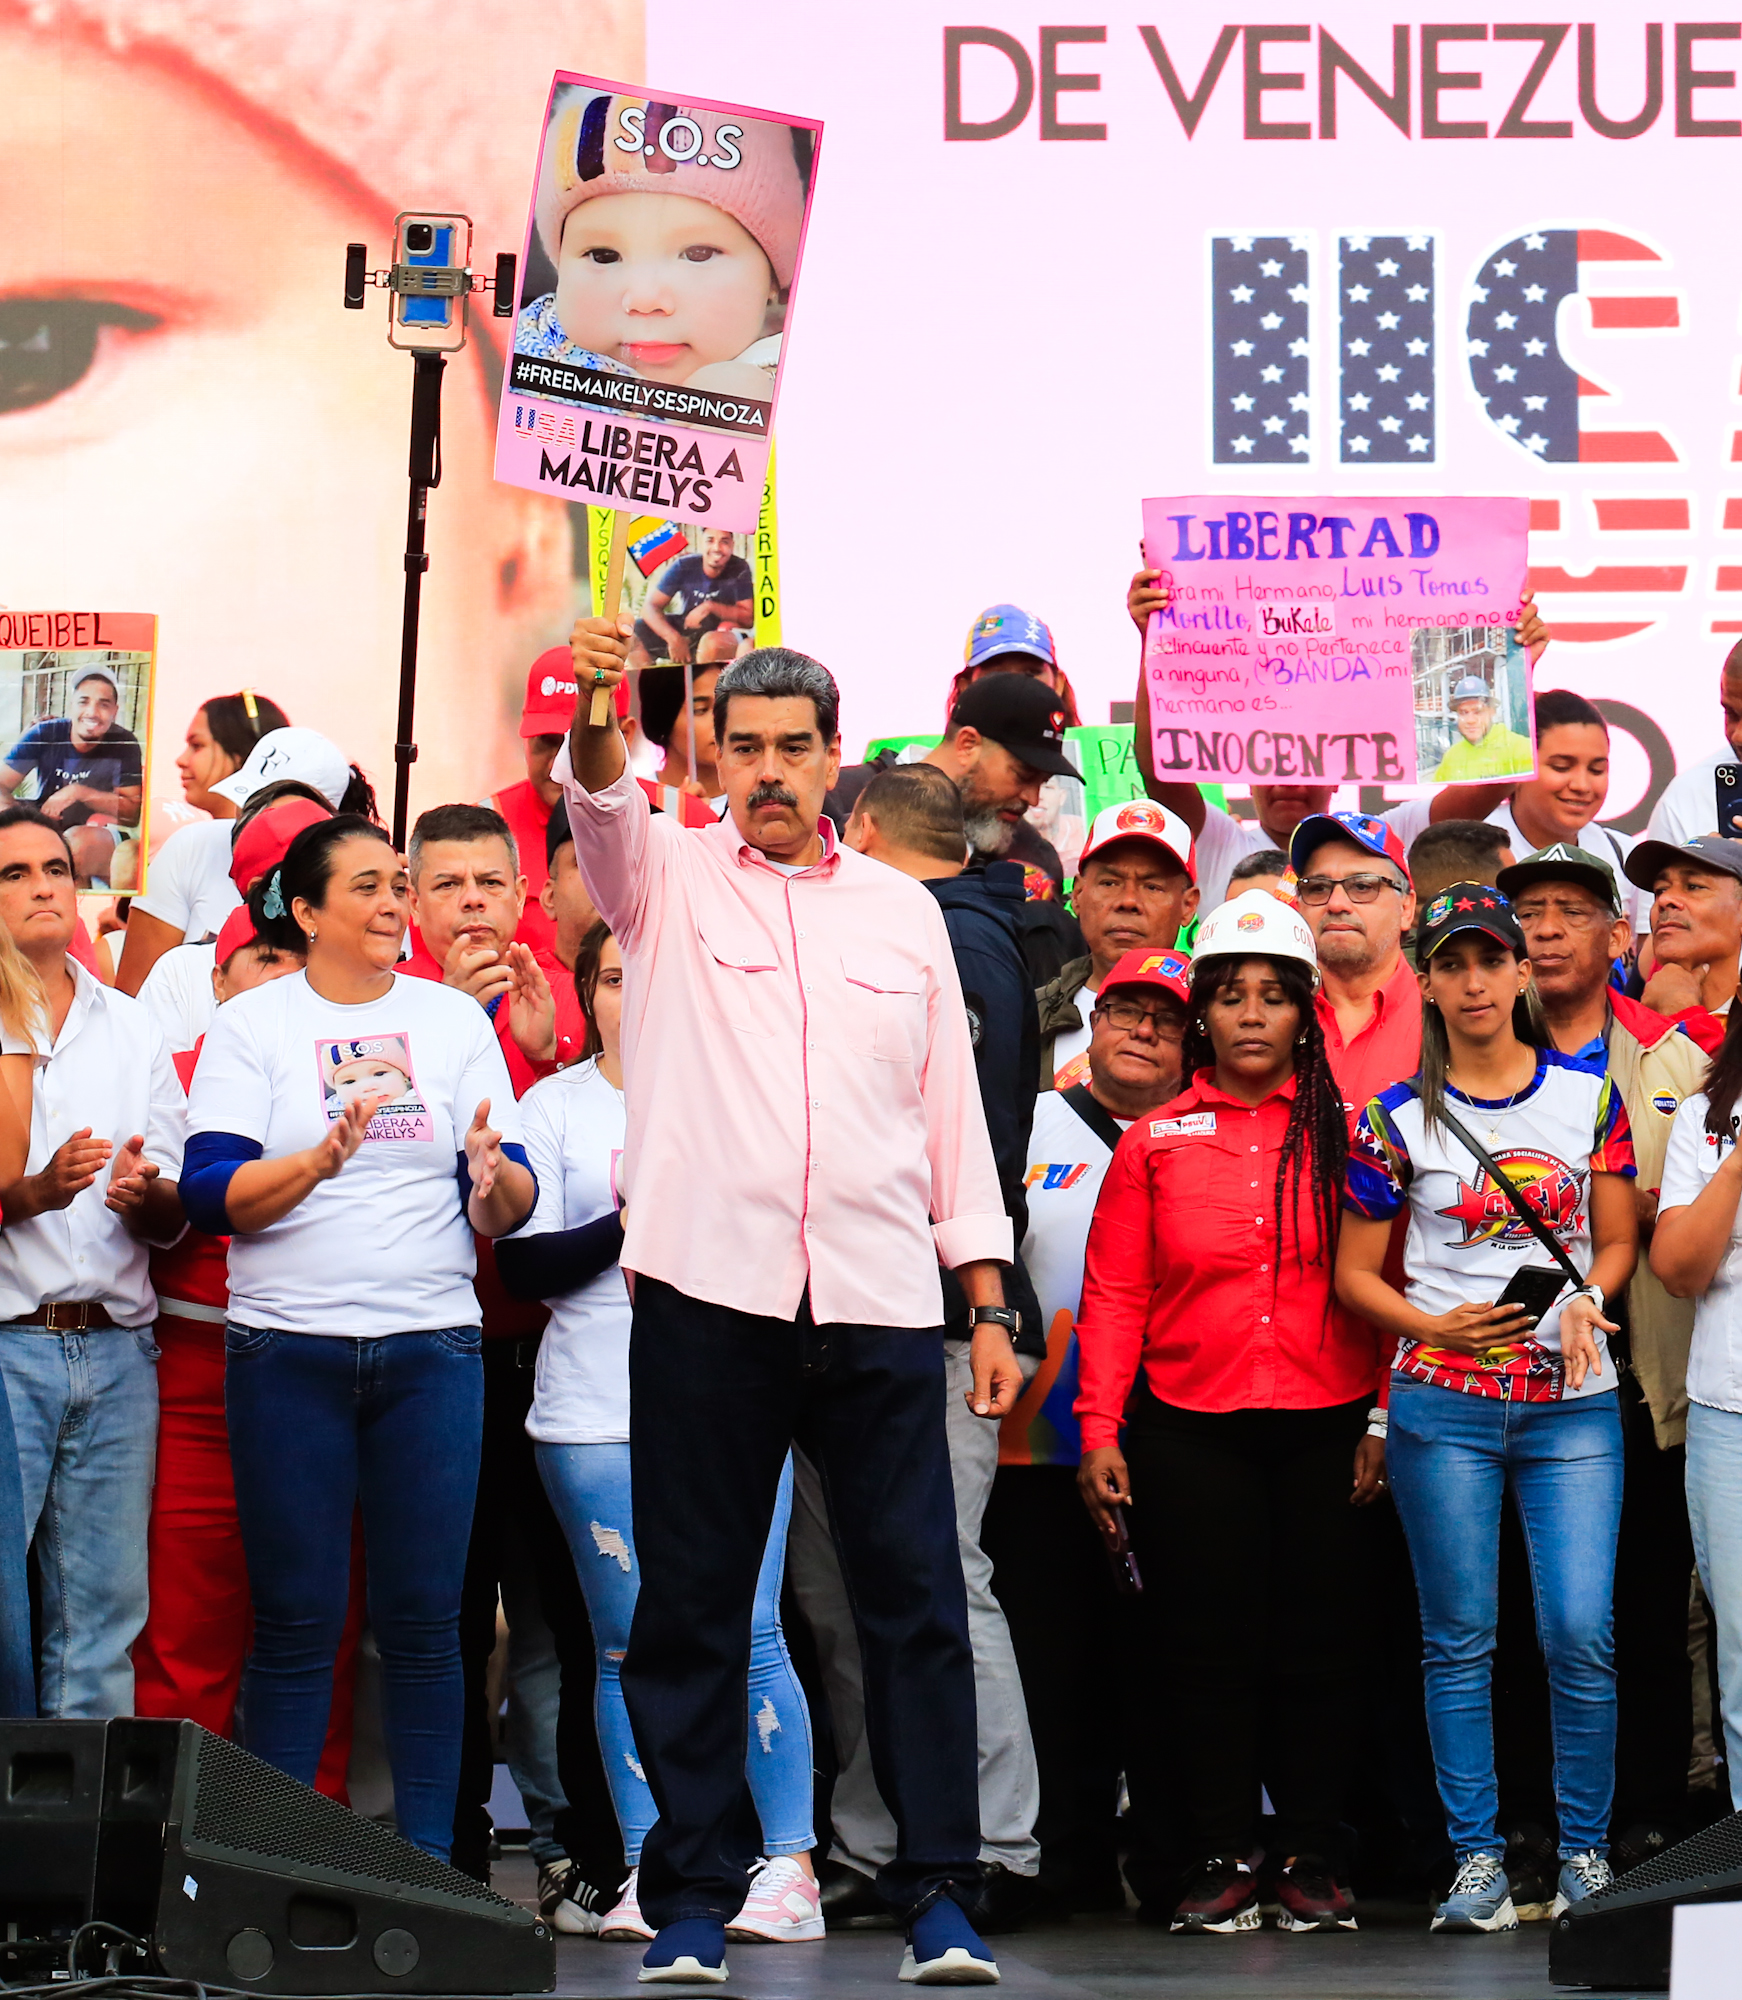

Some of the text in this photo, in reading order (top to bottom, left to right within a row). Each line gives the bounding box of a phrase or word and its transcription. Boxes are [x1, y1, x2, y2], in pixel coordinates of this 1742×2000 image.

[943, 22, 1742, 141] DE VENEZUE
[613, 106, 744, 170] S.O.S
[515, 361, 766, 427] #FREEMAIKELYSESPINOZA
[513, 404, 745, 482] USA LIBERA A
[539, 448, 713, 513] MAIKELYS
[758, 476, 775, 618] BERTAD
[1166, 512, 1441, 562] LIBERTAD
[1201, 584, 1224, 601] mi
[1235, 575, 1337, 601] Hermano,
[1409, 567, 1489, 597] Tomas
[1352, 614, 1373, 629] mi
[1384, 606, 1469, 629] hermano
[1475, 611, 1500, 625] no
[1153, 636, 1250, 656] delincuente
[1257, 640, 1270, 668] y
[1275, 642, 1299, 656] no
[1152, 669, 1164, 682] a
[1168, 666, 1250, 695] ninguna,
[1385, 665, 1409, 678] mi
[1154, 691, 1246, 714] hermano
[1157, 727, 1405, 782] INOCENTE
[342, 1041, 384, 1056] S.O.S
[363, 1127, 416, 1141] AIKELYS
[414, 1117, 425, 1128] A
